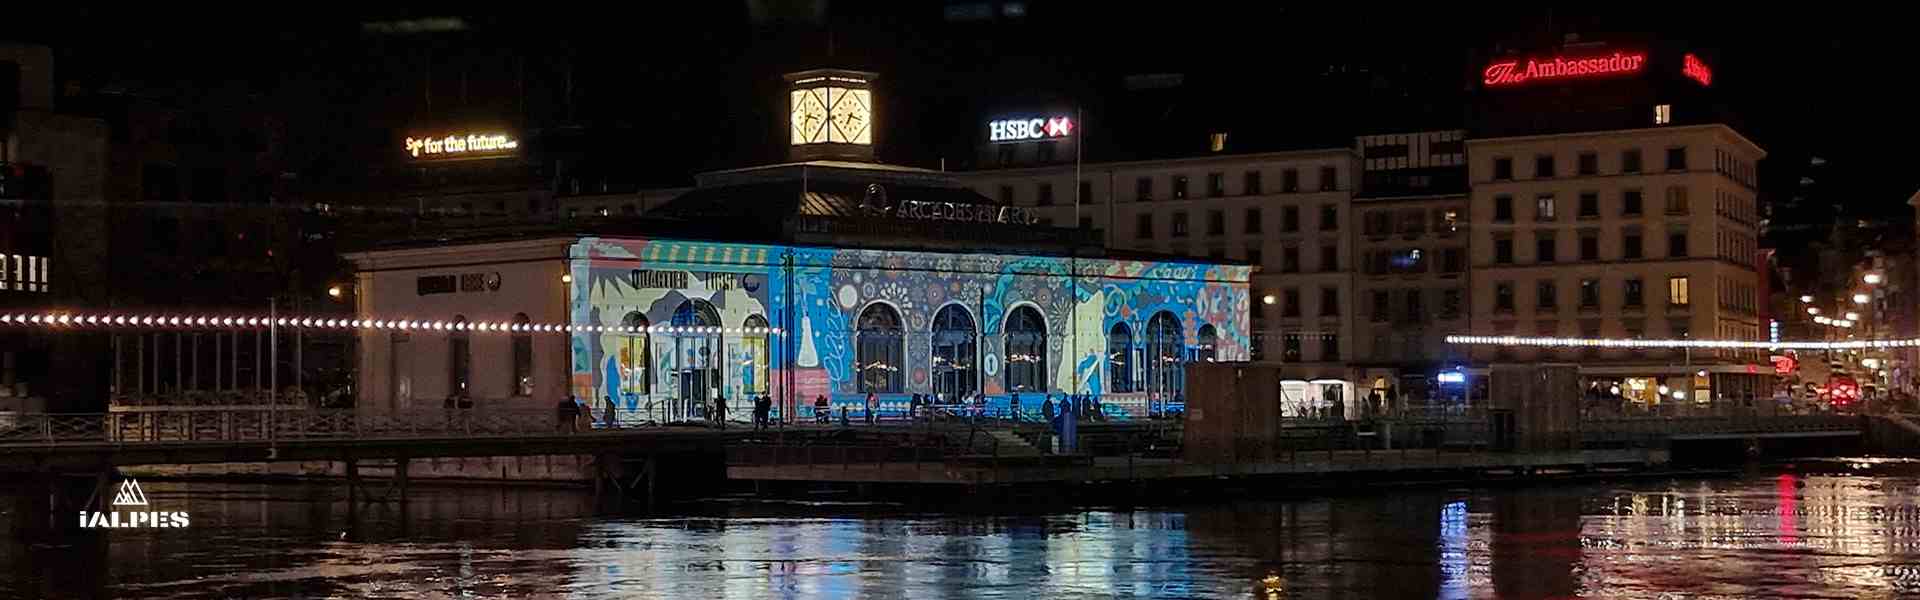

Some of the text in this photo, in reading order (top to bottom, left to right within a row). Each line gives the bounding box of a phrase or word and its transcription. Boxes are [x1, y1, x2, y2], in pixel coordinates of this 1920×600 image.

[1484, 53, 1643, 84] The Ambassador
[989, 118, 1044, 141] HSBC
[424, 137, 443, 153] for
[445, 136, 466, 152] the
